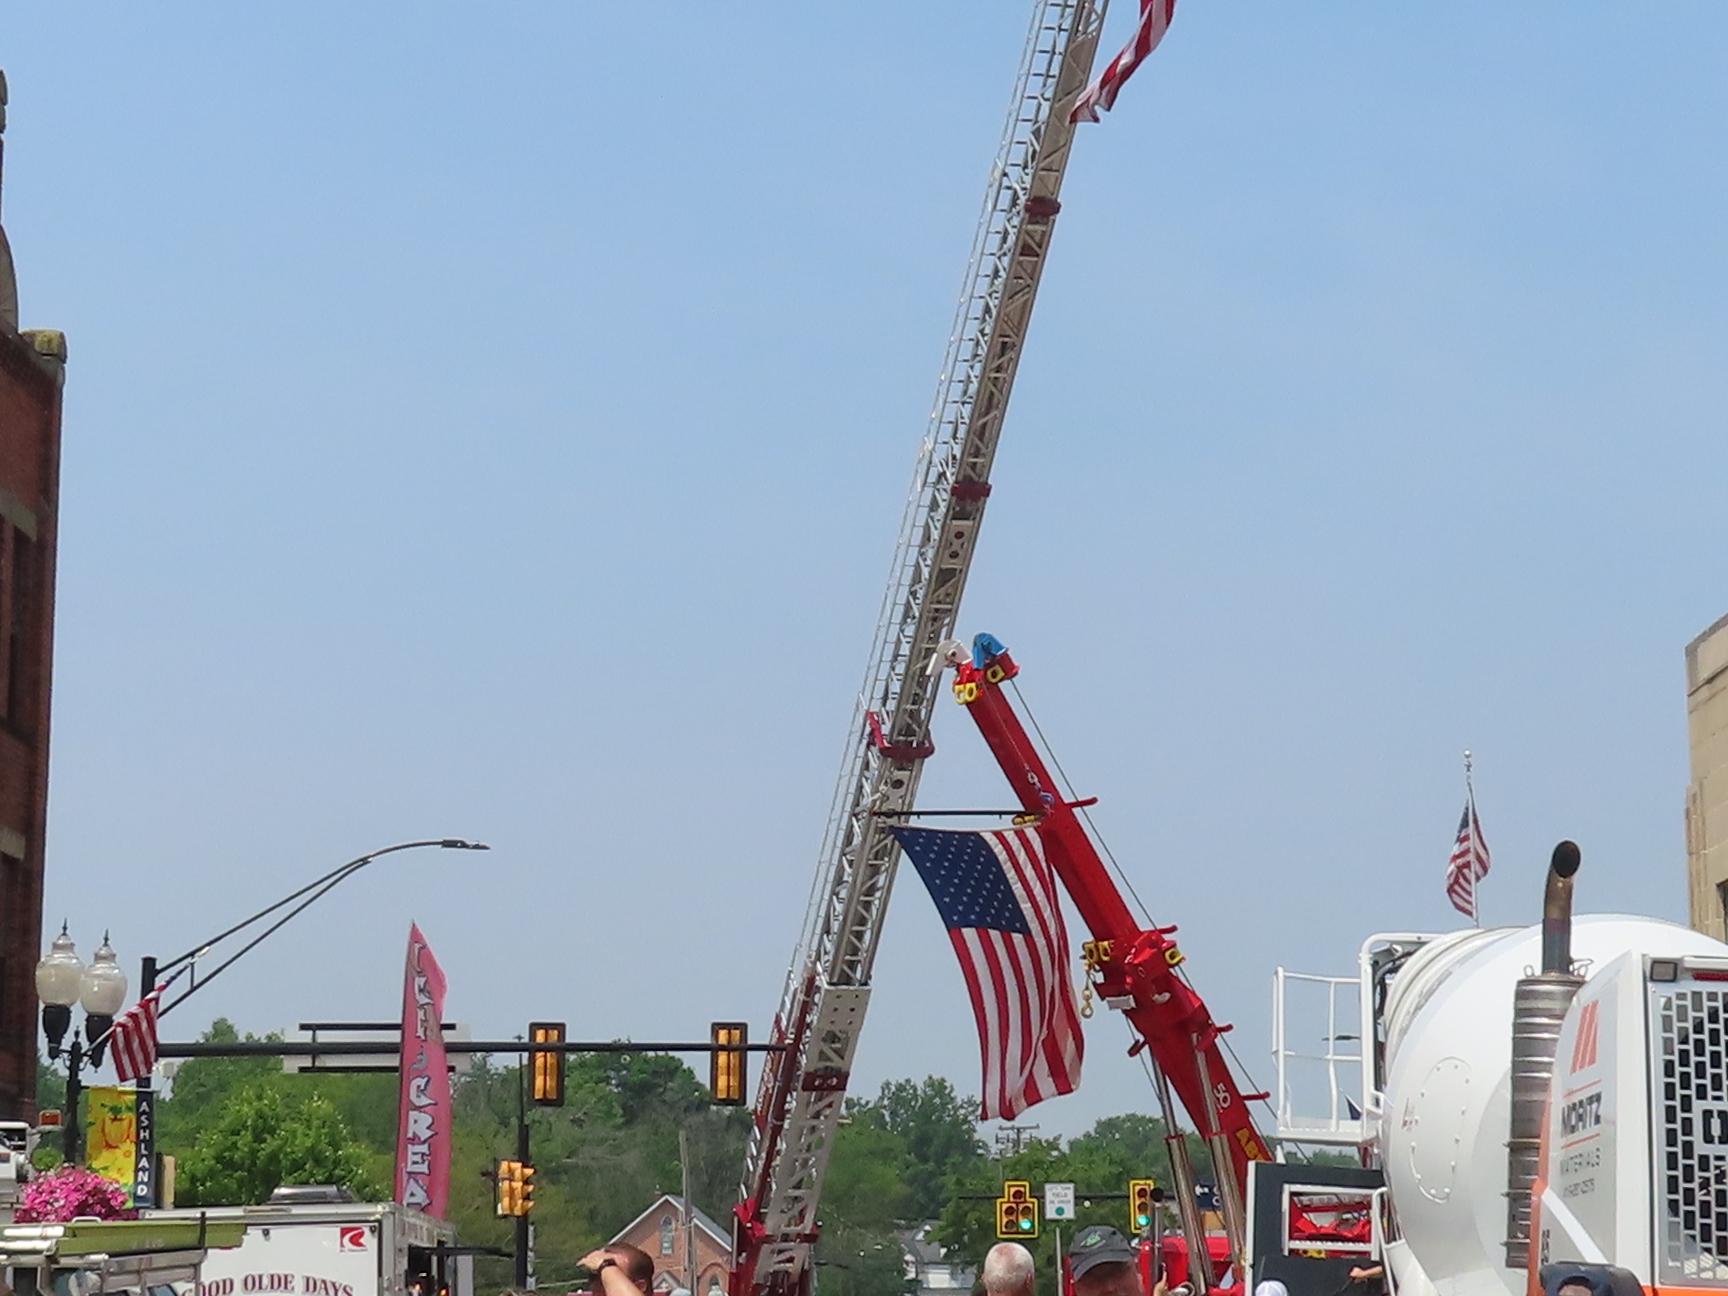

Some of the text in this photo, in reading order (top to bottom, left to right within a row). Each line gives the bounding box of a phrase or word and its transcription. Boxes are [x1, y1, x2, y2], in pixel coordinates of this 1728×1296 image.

[1560, 1091, 1602, 1138] MORITZ
[136, 1101, 150, 1196] ASHLAND
[242, 1273, 296, 1295] OLDE
